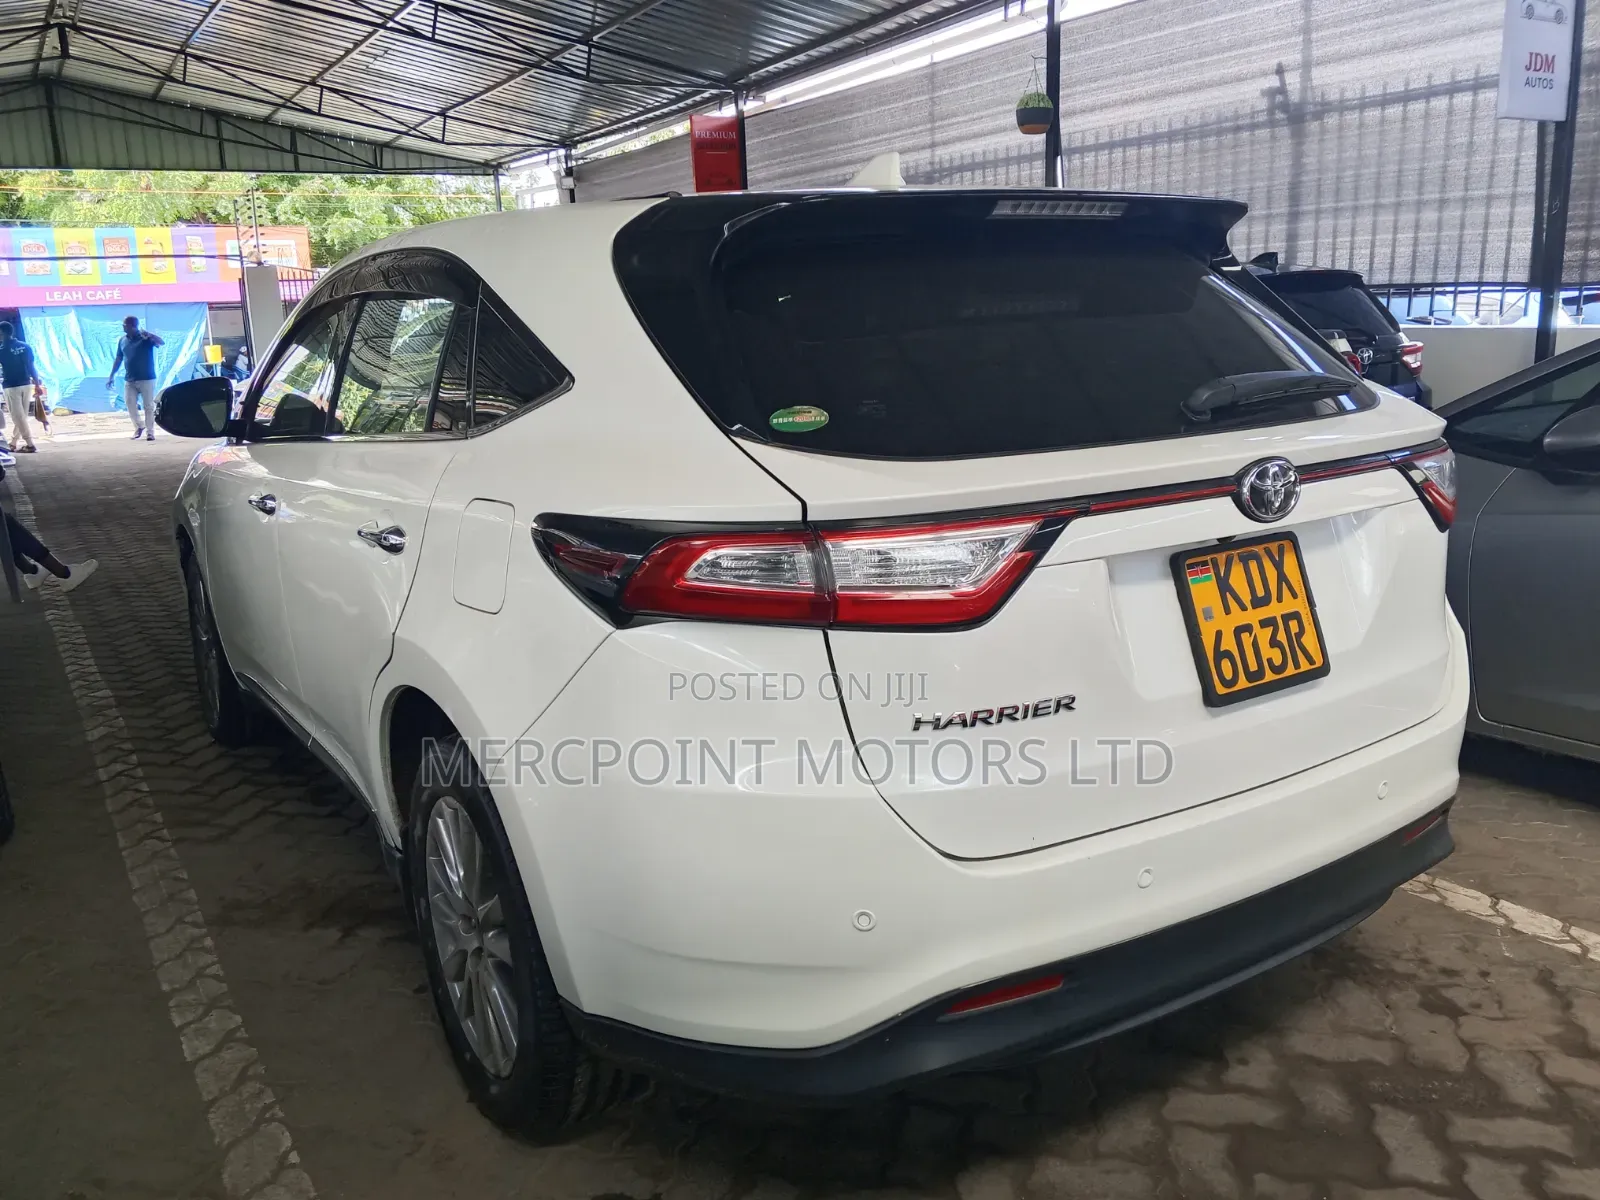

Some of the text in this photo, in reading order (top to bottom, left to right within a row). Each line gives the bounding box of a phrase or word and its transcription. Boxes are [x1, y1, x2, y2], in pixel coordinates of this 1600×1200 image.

[1525, 52, 1556, 74] JDM
[1524, 76, 1554, 90] AUTOS
[695, 130, 736, 139] PREMIUM
[45, 287, 122, 302] LEAH CAFÉ
[1211, 543, 1299, 616] KDX
[1212, 610, 1317, 689] 603R
[911, 693, 1077, 732] HARRIER
